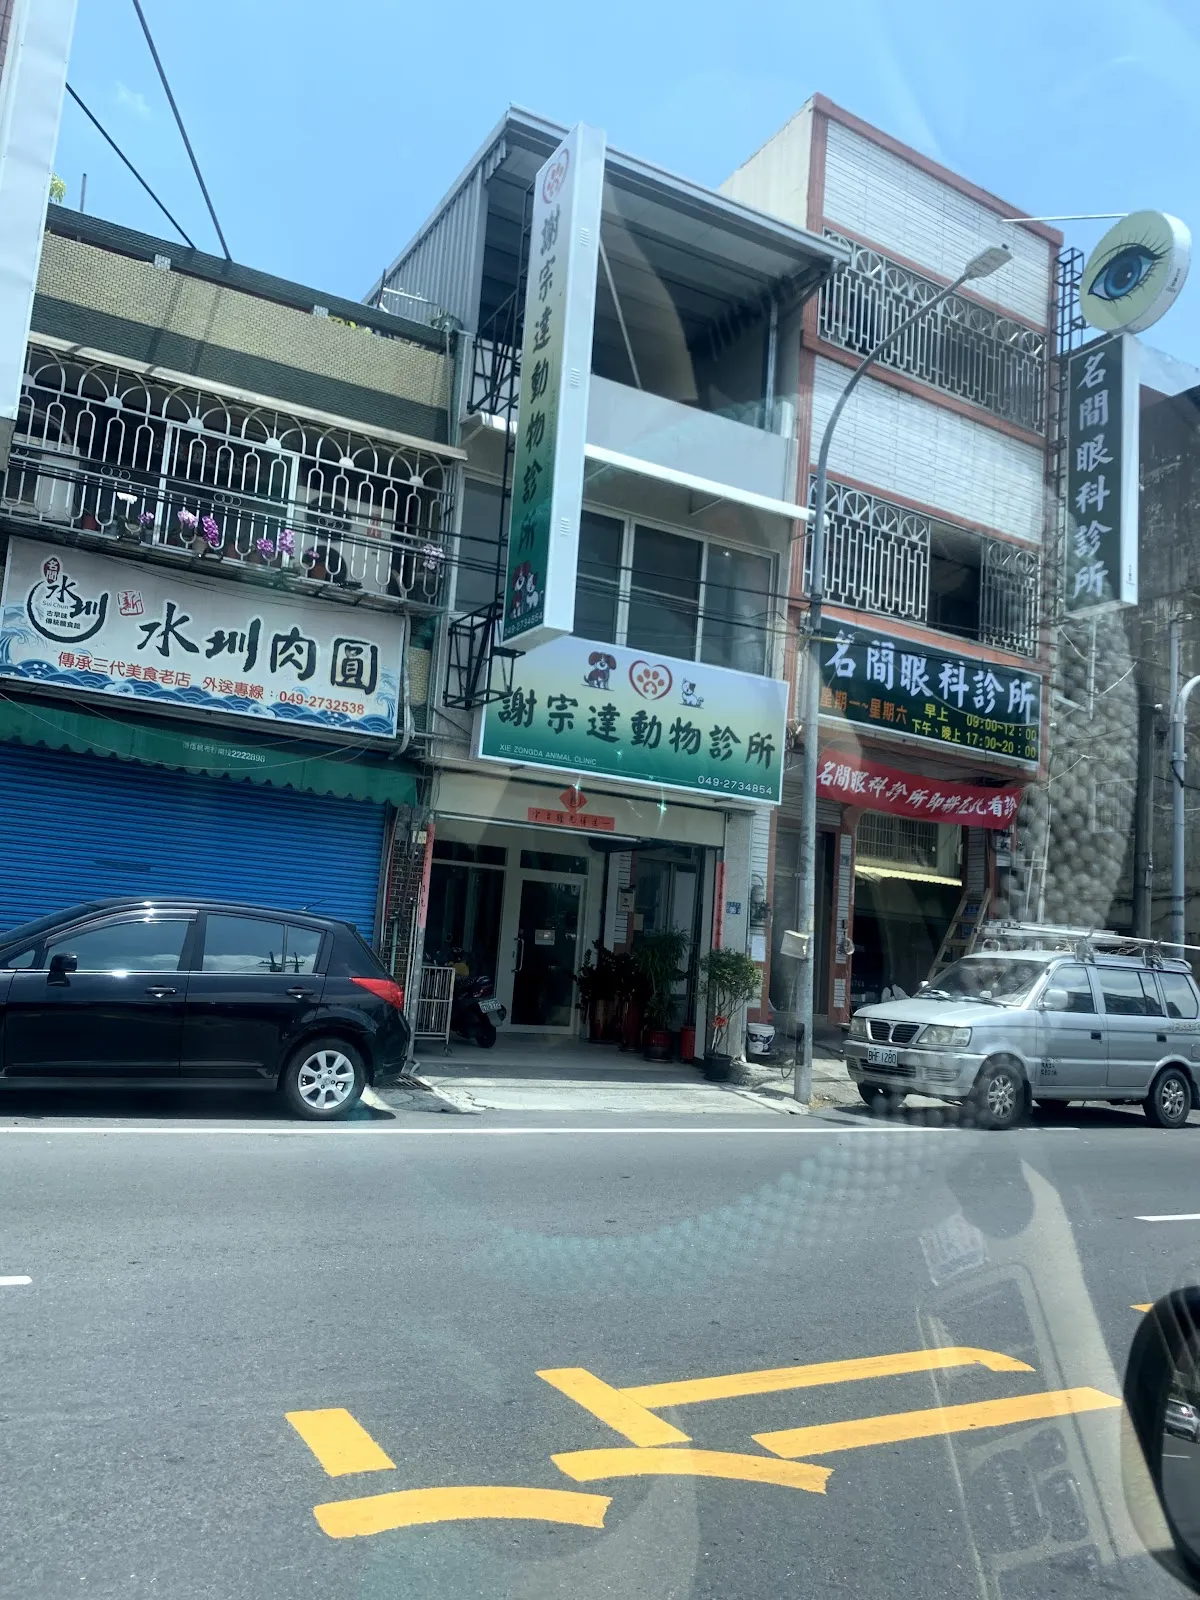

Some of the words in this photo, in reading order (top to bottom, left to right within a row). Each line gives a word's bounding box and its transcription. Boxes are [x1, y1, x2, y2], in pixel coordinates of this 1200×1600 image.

[1073, 351, 1114, 599] 名間眼科診所
[57, 651, 192, 688] 傳承三代美食老店
[137, 602, 379, 696] 水圳肉圓
[824, 629, 1037, 724] 名間眼科診所
[497, 686, 776, 769] 謝宗達動物診所
[924, 703, 949, 722] 早上
[499, 744, 511, 752] XIE
[514, 745, 543, 757] ZONGDA
[545, 751, 572, 762] ANIMAL
[697, 775, 773, 795] 049-2734854
